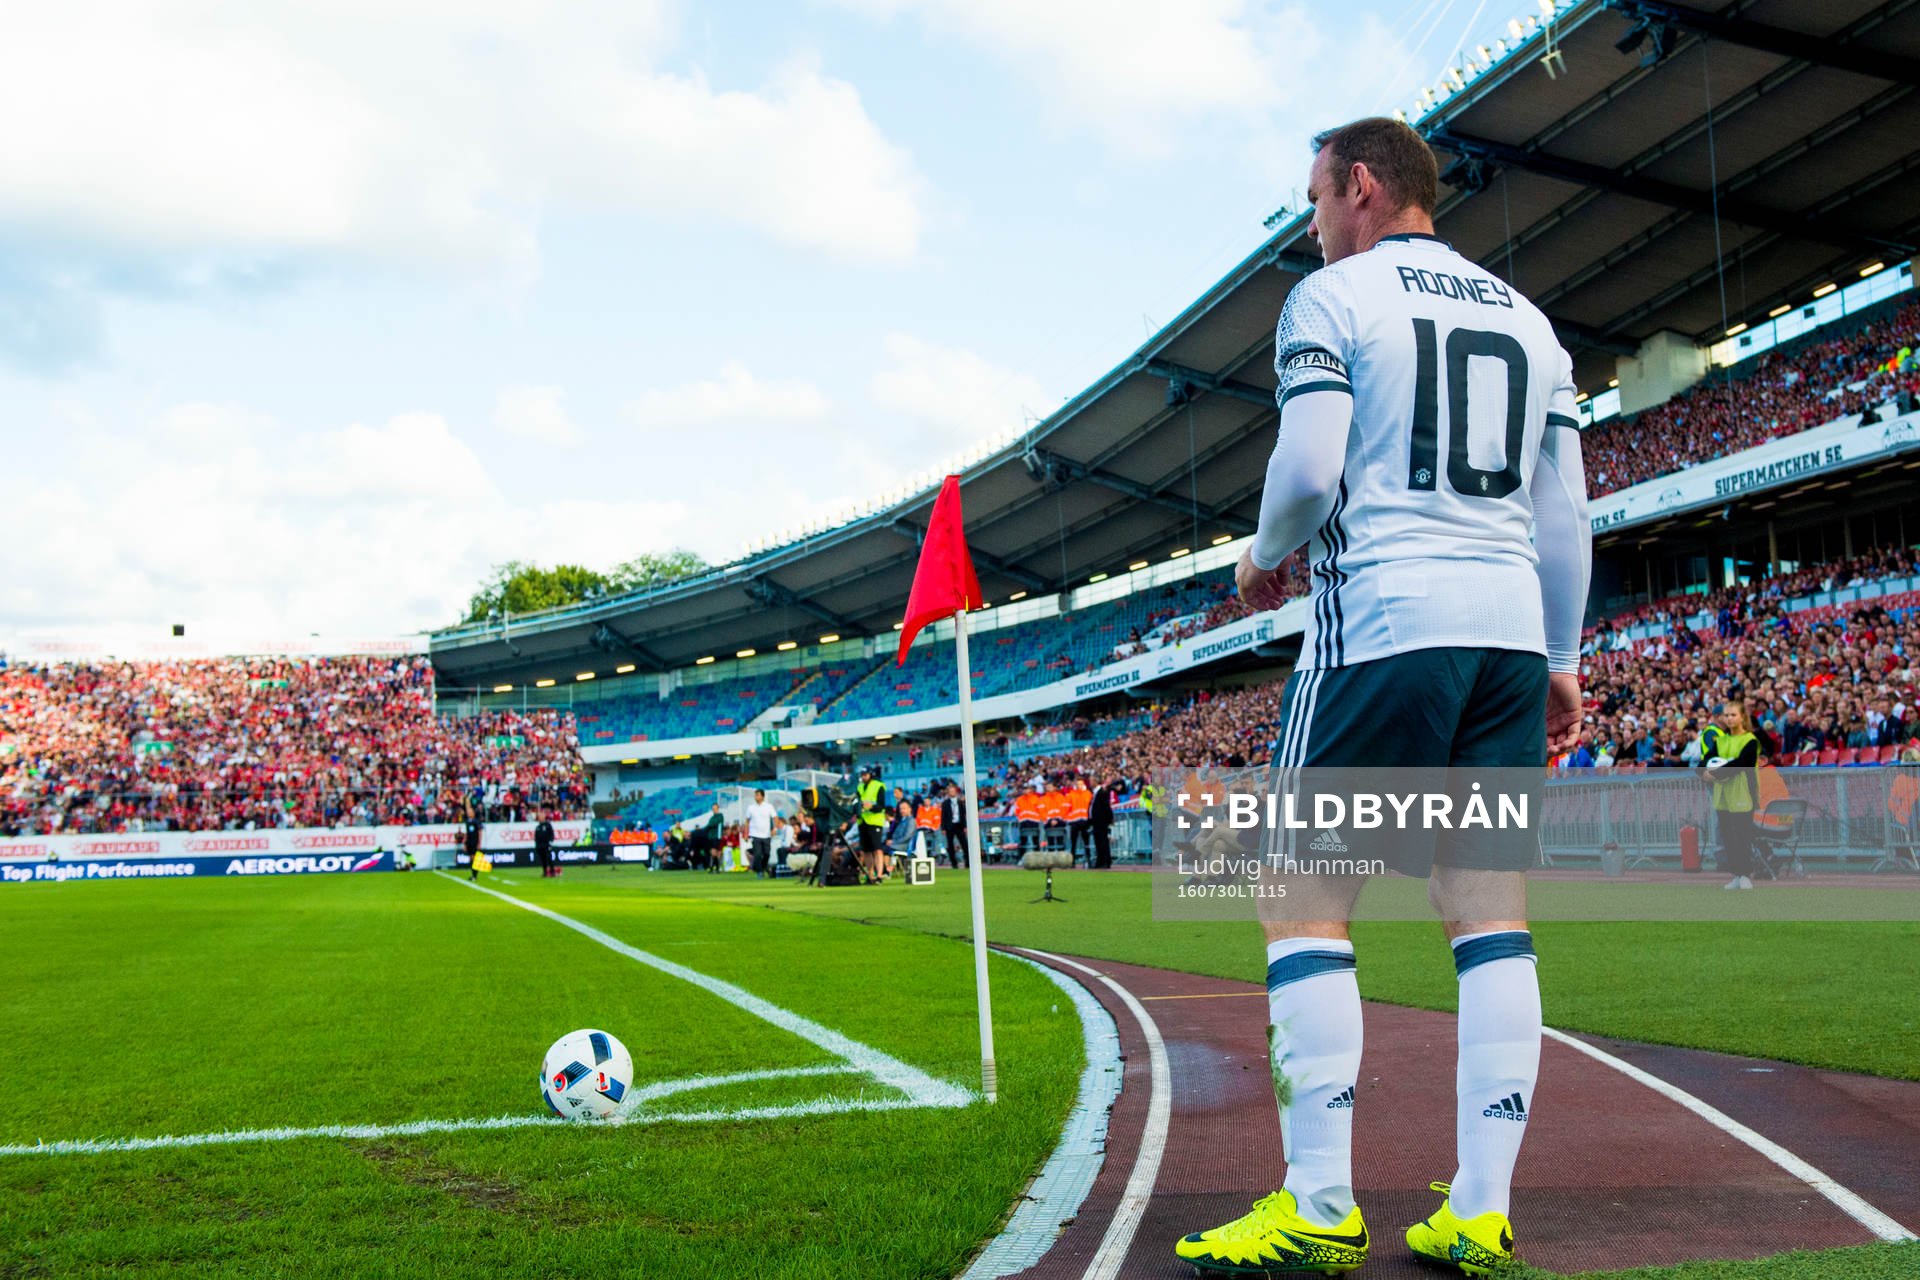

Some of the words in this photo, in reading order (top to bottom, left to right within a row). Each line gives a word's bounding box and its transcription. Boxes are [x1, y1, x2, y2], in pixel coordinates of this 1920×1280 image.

[1396, 265, 1514, 309] ROONEY
[1408, 317, 1529, 499] 10
[1715, 450, 1820, 496] SUPERMATCHEN
[302, 834, 376, 847] BAUHAUS
[1310, 840, 1348, 852] adidas
[1, 865, 33, 882] Top
[36, 864, 84, 882] Flight
[87, 862, 195, 878] Performance
[226, 855, 356, 875] AEROFLOT
[1483, 1108, 1528, 1122] adidas
